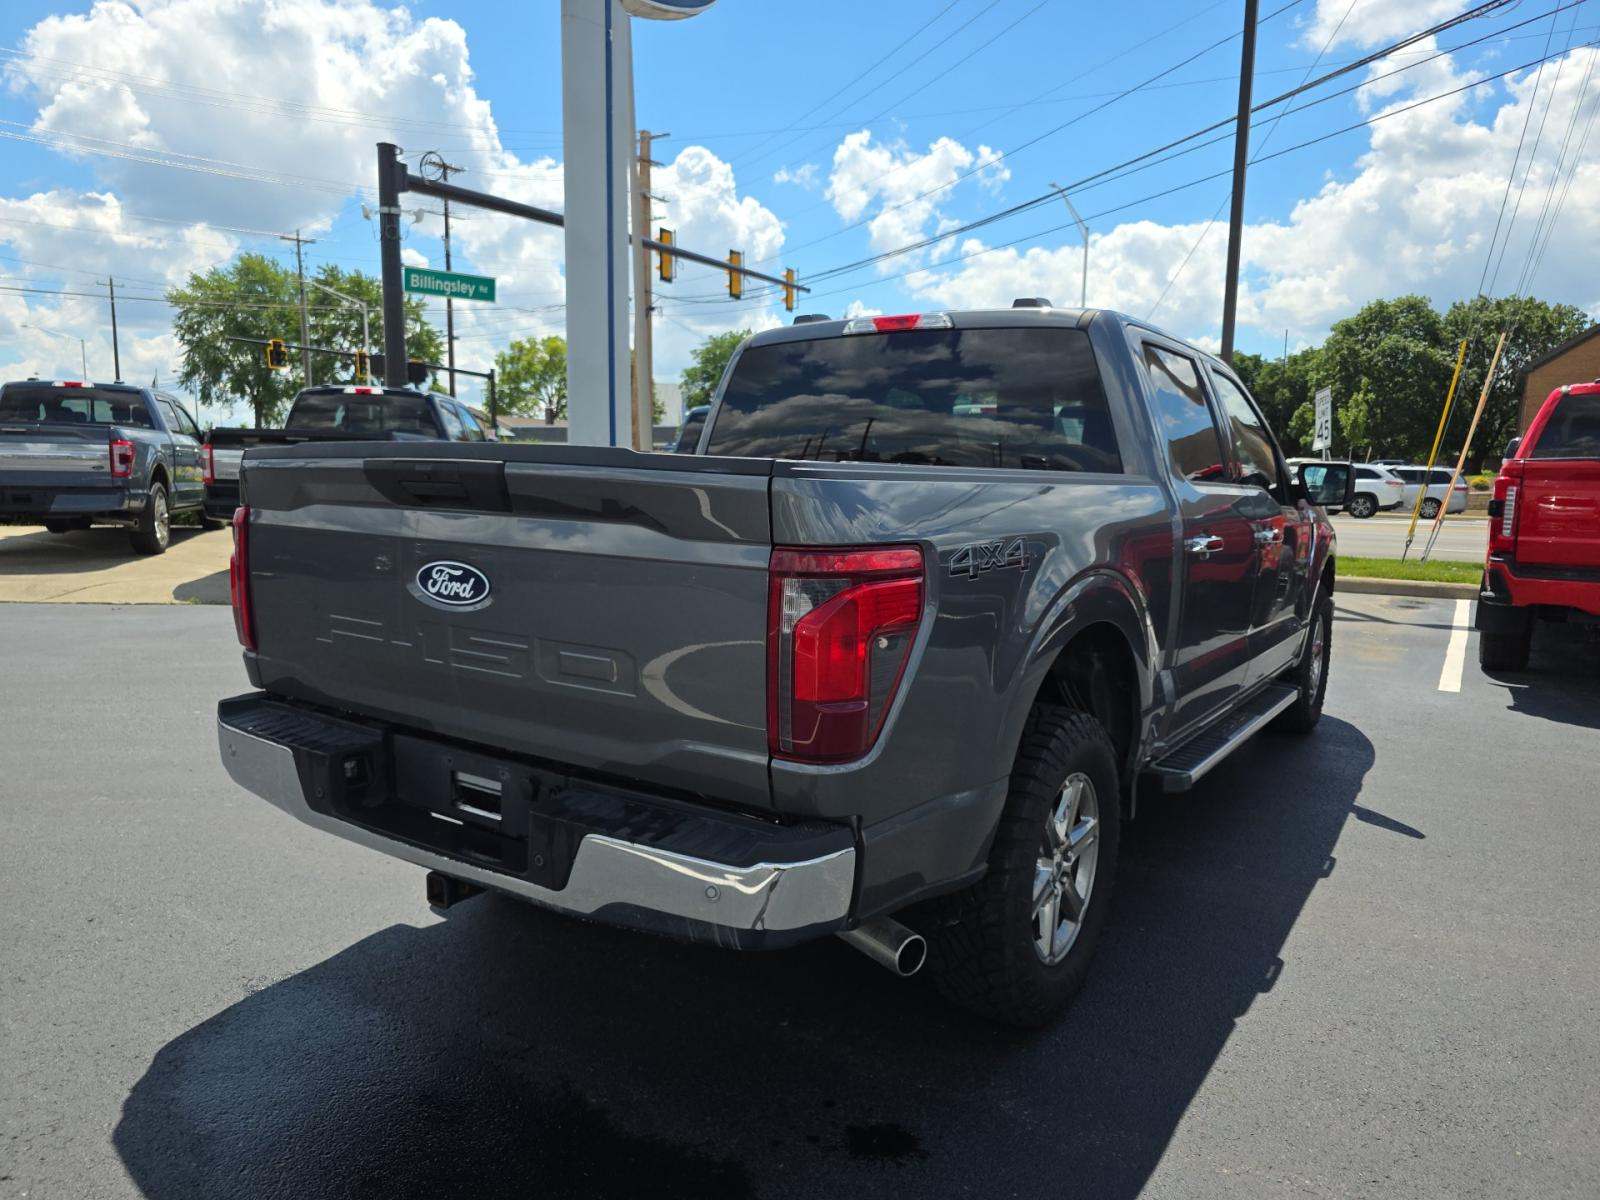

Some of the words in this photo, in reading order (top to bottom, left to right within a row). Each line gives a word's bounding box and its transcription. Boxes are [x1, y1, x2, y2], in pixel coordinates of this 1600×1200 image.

[410, 274, 475, 297] Billingsley
[1317, 419, 1329, 441] 45
[427, 566, 475, 599] Ford
